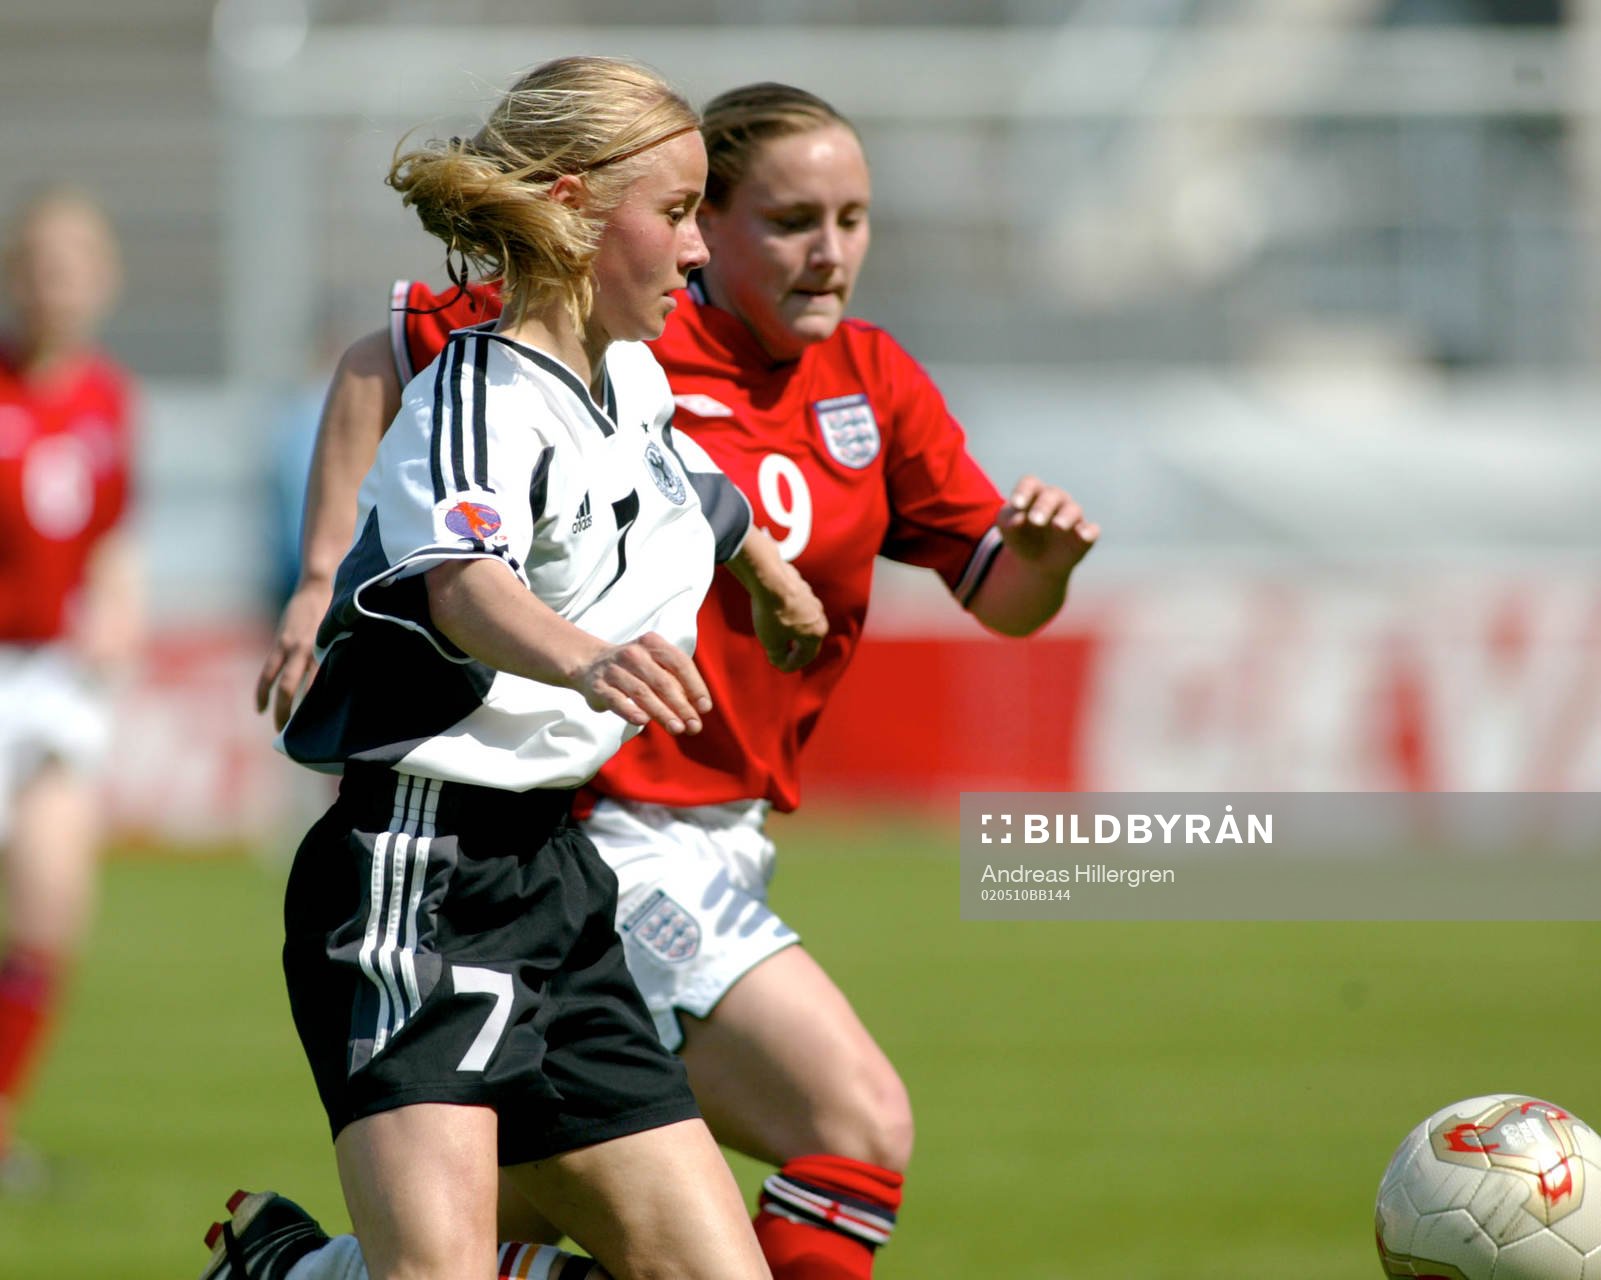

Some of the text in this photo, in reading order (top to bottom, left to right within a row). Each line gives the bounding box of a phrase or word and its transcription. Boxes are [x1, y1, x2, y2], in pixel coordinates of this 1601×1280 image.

[594, 487, 640, 602] 7
[758, 452, 812, 561] 9
[452, 965, 514, 1071] 7
